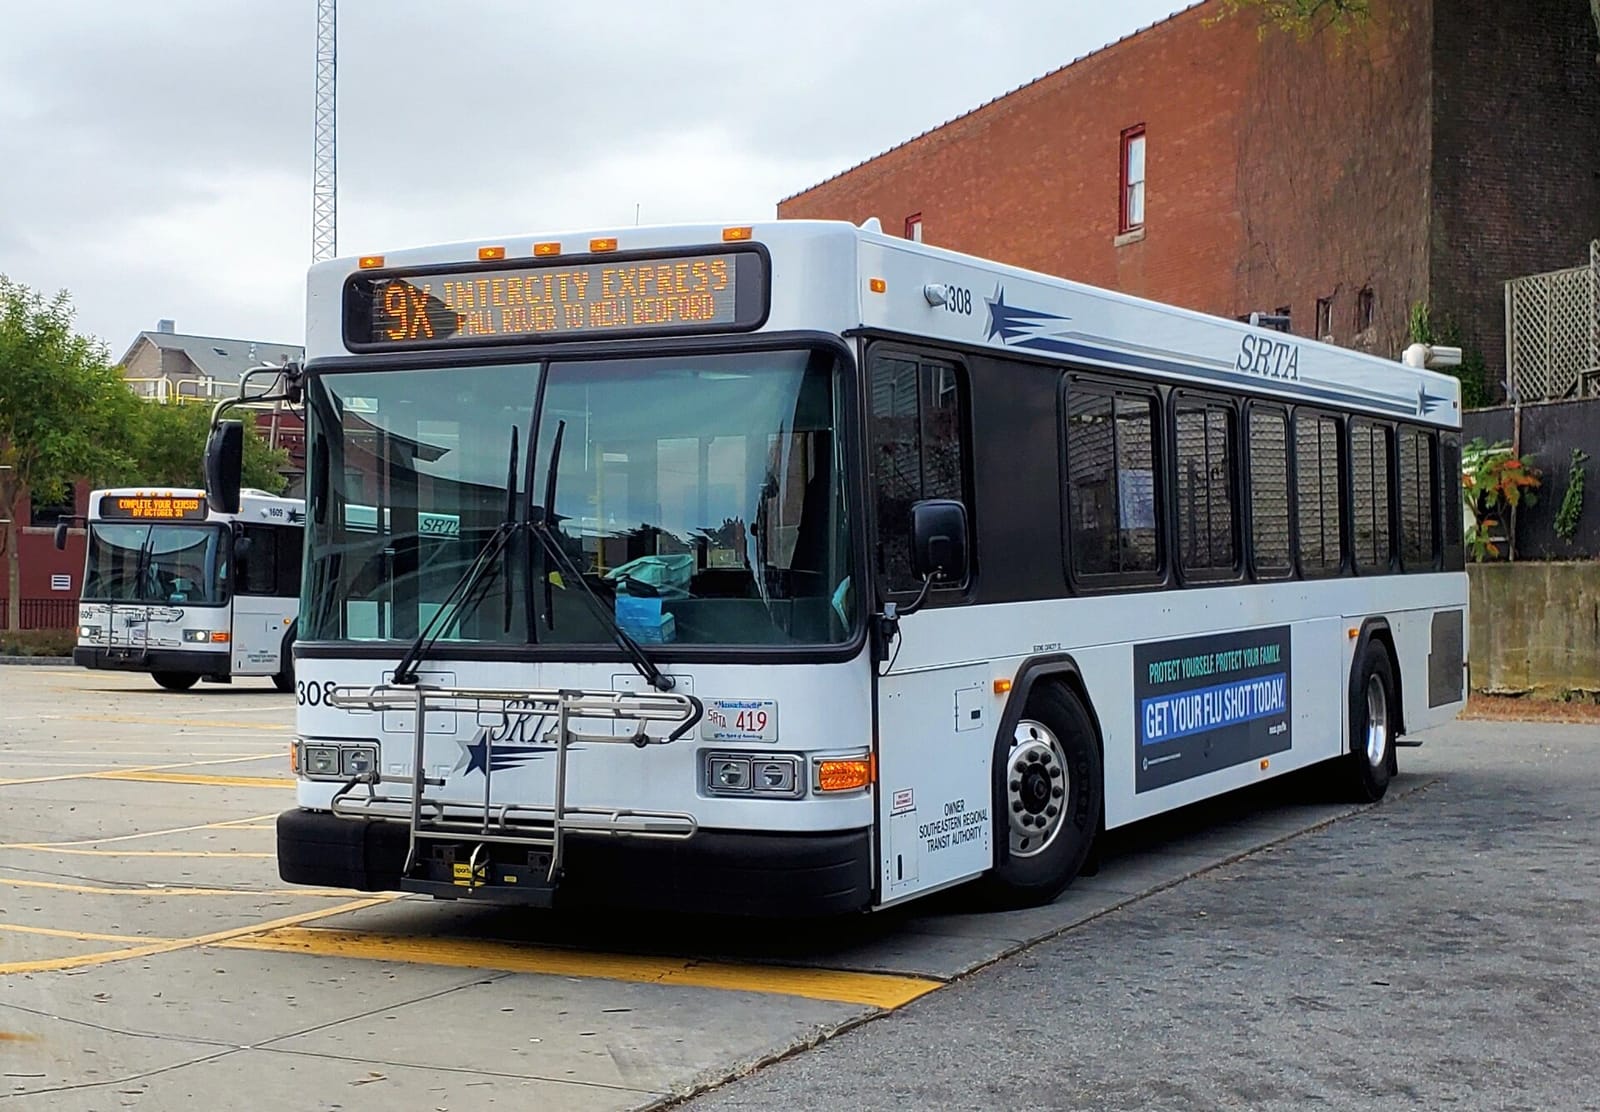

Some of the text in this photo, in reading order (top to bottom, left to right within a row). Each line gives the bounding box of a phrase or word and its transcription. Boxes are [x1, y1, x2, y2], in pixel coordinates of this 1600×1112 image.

[443, 260, 728, 310] INTERCITY EXPRESS
[384, 284, 435, 340] 9X
[456, 293, 715, 336] FALL RIVER TO NEW BEDFORD
[1235, 334, 1299, 381] SRTA
[119, 499, 199, 510] COMPLETE YOUR CENSUS
[132, 508, 143, 517] BY
[143, 508, 174, 518] OCTOBER
[420, 518, 460, 533] SRT
[1149, 659, 1181, 684] PROTECT
[1181, 653, 1215, 679] YOURSELF.
[1215, 649, 1243, 673] PROTECT
[1243, 647, 1259, 670] YOUR
[707, 708, 768, 732] SRTA 419
[1145, 677, 1285, 739] GET YOUR FLU SHOT TODAY.
[919, 808, 988, 839] SOUTHEASTERN REGIONAL
[944, 799, 965, 817] OWNER
[926, 825, 982, 853] TRANSIT AUTHORITY
